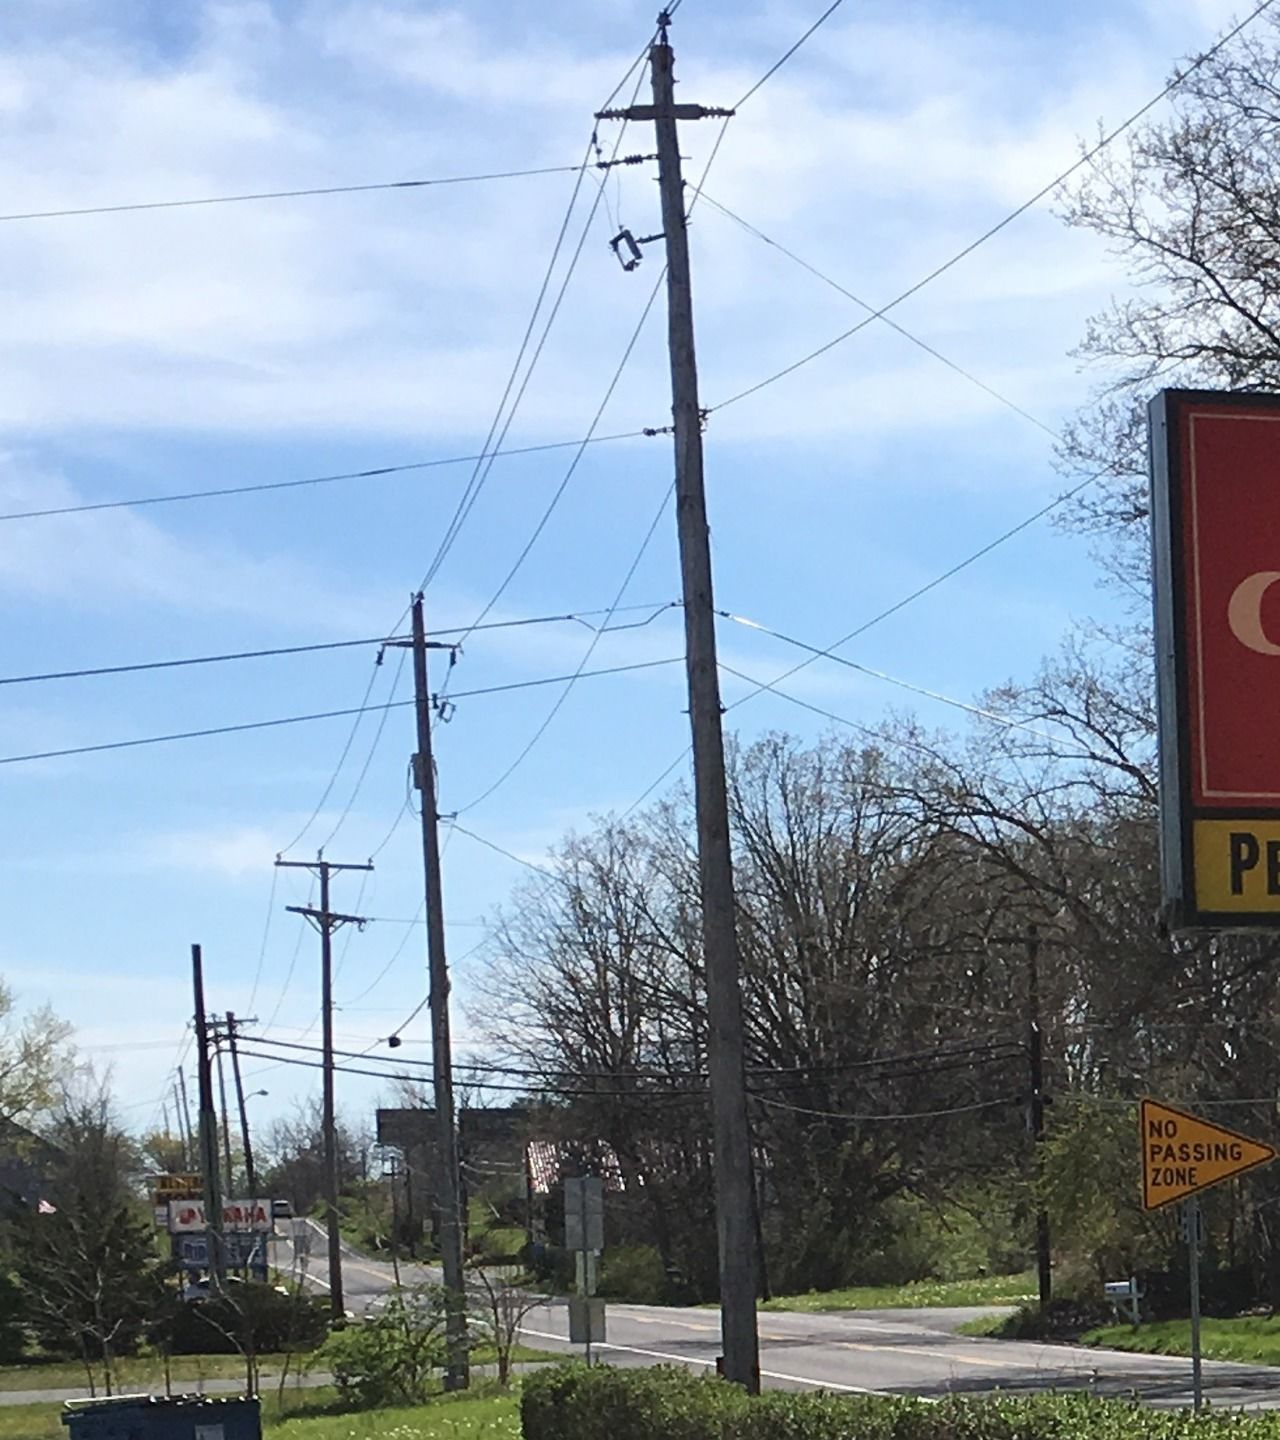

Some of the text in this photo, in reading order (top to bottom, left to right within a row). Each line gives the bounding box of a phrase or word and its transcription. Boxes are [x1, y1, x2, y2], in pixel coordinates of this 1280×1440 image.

[1149, 1120, 1177, 1138] NO
[1150, 1143, 1243, 1162] PASSING
[1151, 1168, 1198, 1187] ZONE
